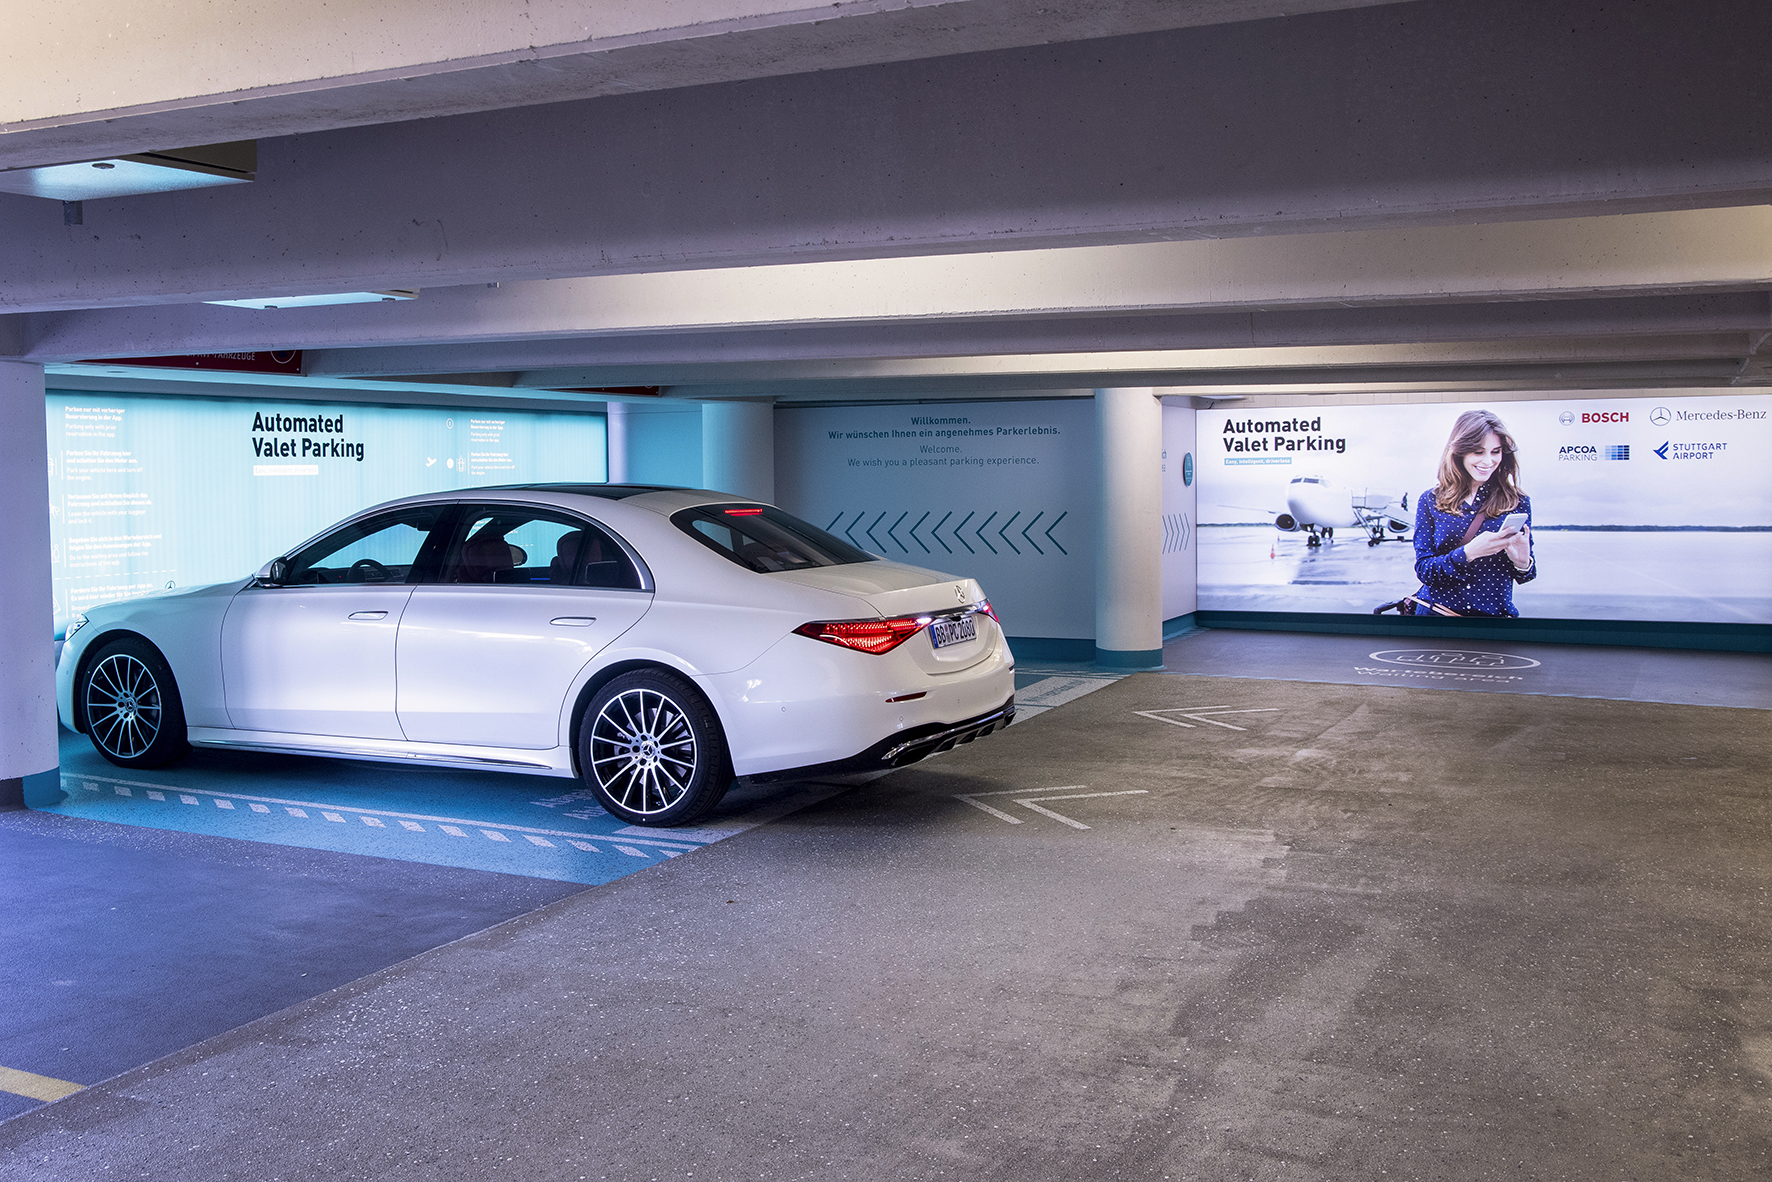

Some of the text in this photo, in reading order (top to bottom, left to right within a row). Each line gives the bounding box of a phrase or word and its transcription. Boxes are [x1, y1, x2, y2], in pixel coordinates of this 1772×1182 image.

[910, 416, 971, 425] Willkommen.
[1582, 412, 1629, 423] BOSCH
[1676, 409, 1767, 421] Mercedes-Benz
[252, 412, 344, 434] Automated
[1223, 416, 1321, 434] Automated
[828, 426, 1060, 439] Wir wünschen Ihnen ein angenehmes Parkerlebnis.
[252, 437, 364, 462] Valet Parking
[920, 445, 962, 454] Welcome.
[1223, 436, 1346, 454] Valet Parking
[1672, 442, 1728, 451] STUTTGART
[848, 458, 860, 466] We
[862, 458, 882, 466] wish
[884, 460, 900, 468] you
[910, 458, 948, 468] pleasant
[950, 456, 984, 467] parking
[986, 456, 1040, 466] experience.
[1672, 452, 1714, 460] AIRPORT
[936, 625, 946, 644] BB
[948, 622, 960, 642] PC
[1354, 666, 1523, 680] Wartebereich
[1357, 671, 1444, 680] Waiting
